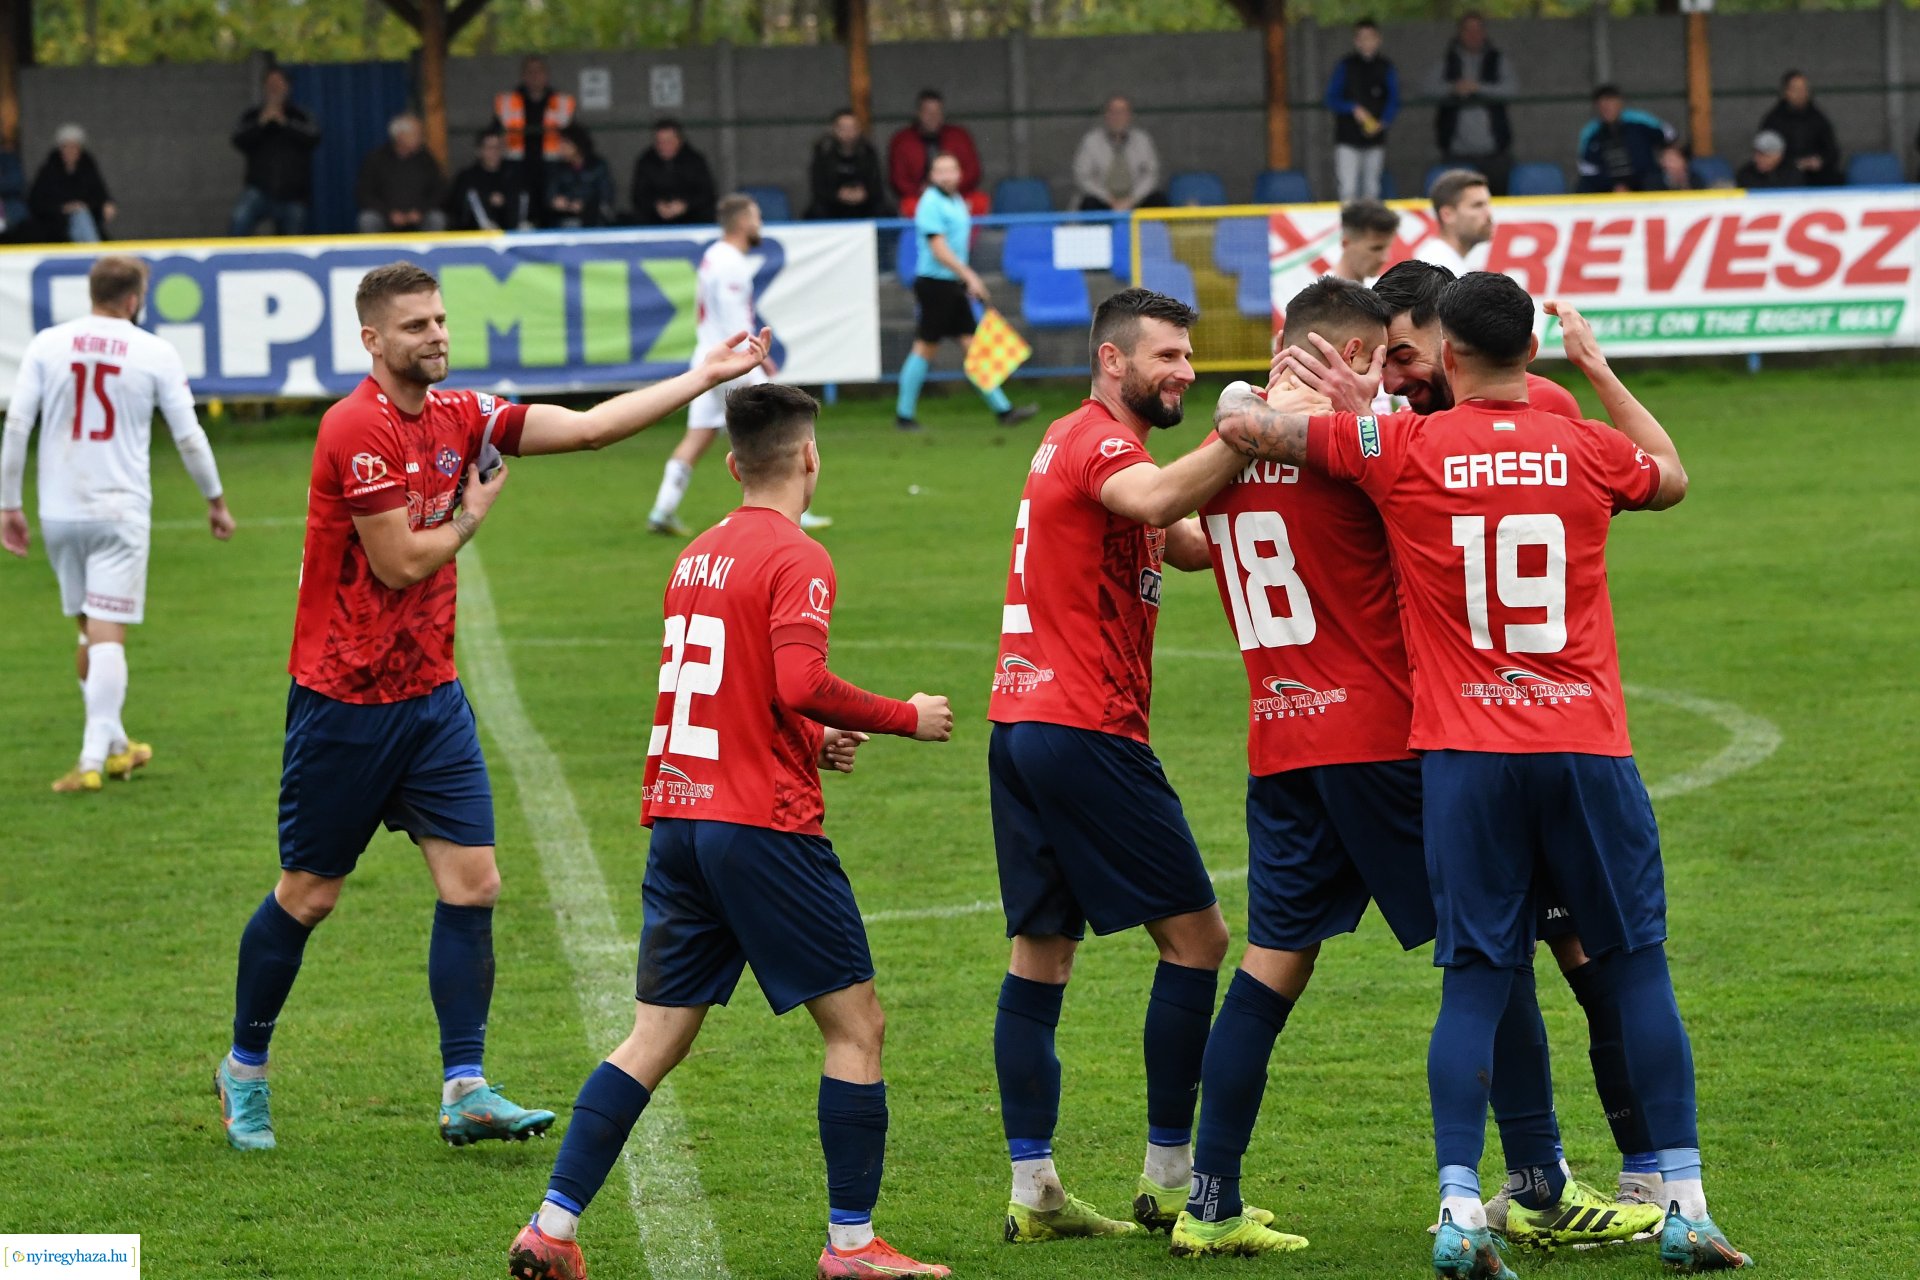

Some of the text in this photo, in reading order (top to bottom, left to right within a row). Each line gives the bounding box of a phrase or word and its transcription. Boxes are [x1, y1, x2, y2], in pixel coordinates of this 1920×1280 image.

[1658, 310, 1698, 336] ON
[1701, 309, 1750, 335] THE
[1753, 306, 1833, 333] RIGHT
[1837, 303, 1897, 331] WAY
[71, 362, 121, 441] 15
[671, 553, 735, 590] PATAKI
[1206, 511, 1317, 651] 18
[1452, 513, 1568, 654] 19
[647, 613, 726, 761] 22
[1291, 687, 1348, 710] TRANS
[1530, 683, 1592, 698] TRANS
[667, 780, 715, 799] TRANS
